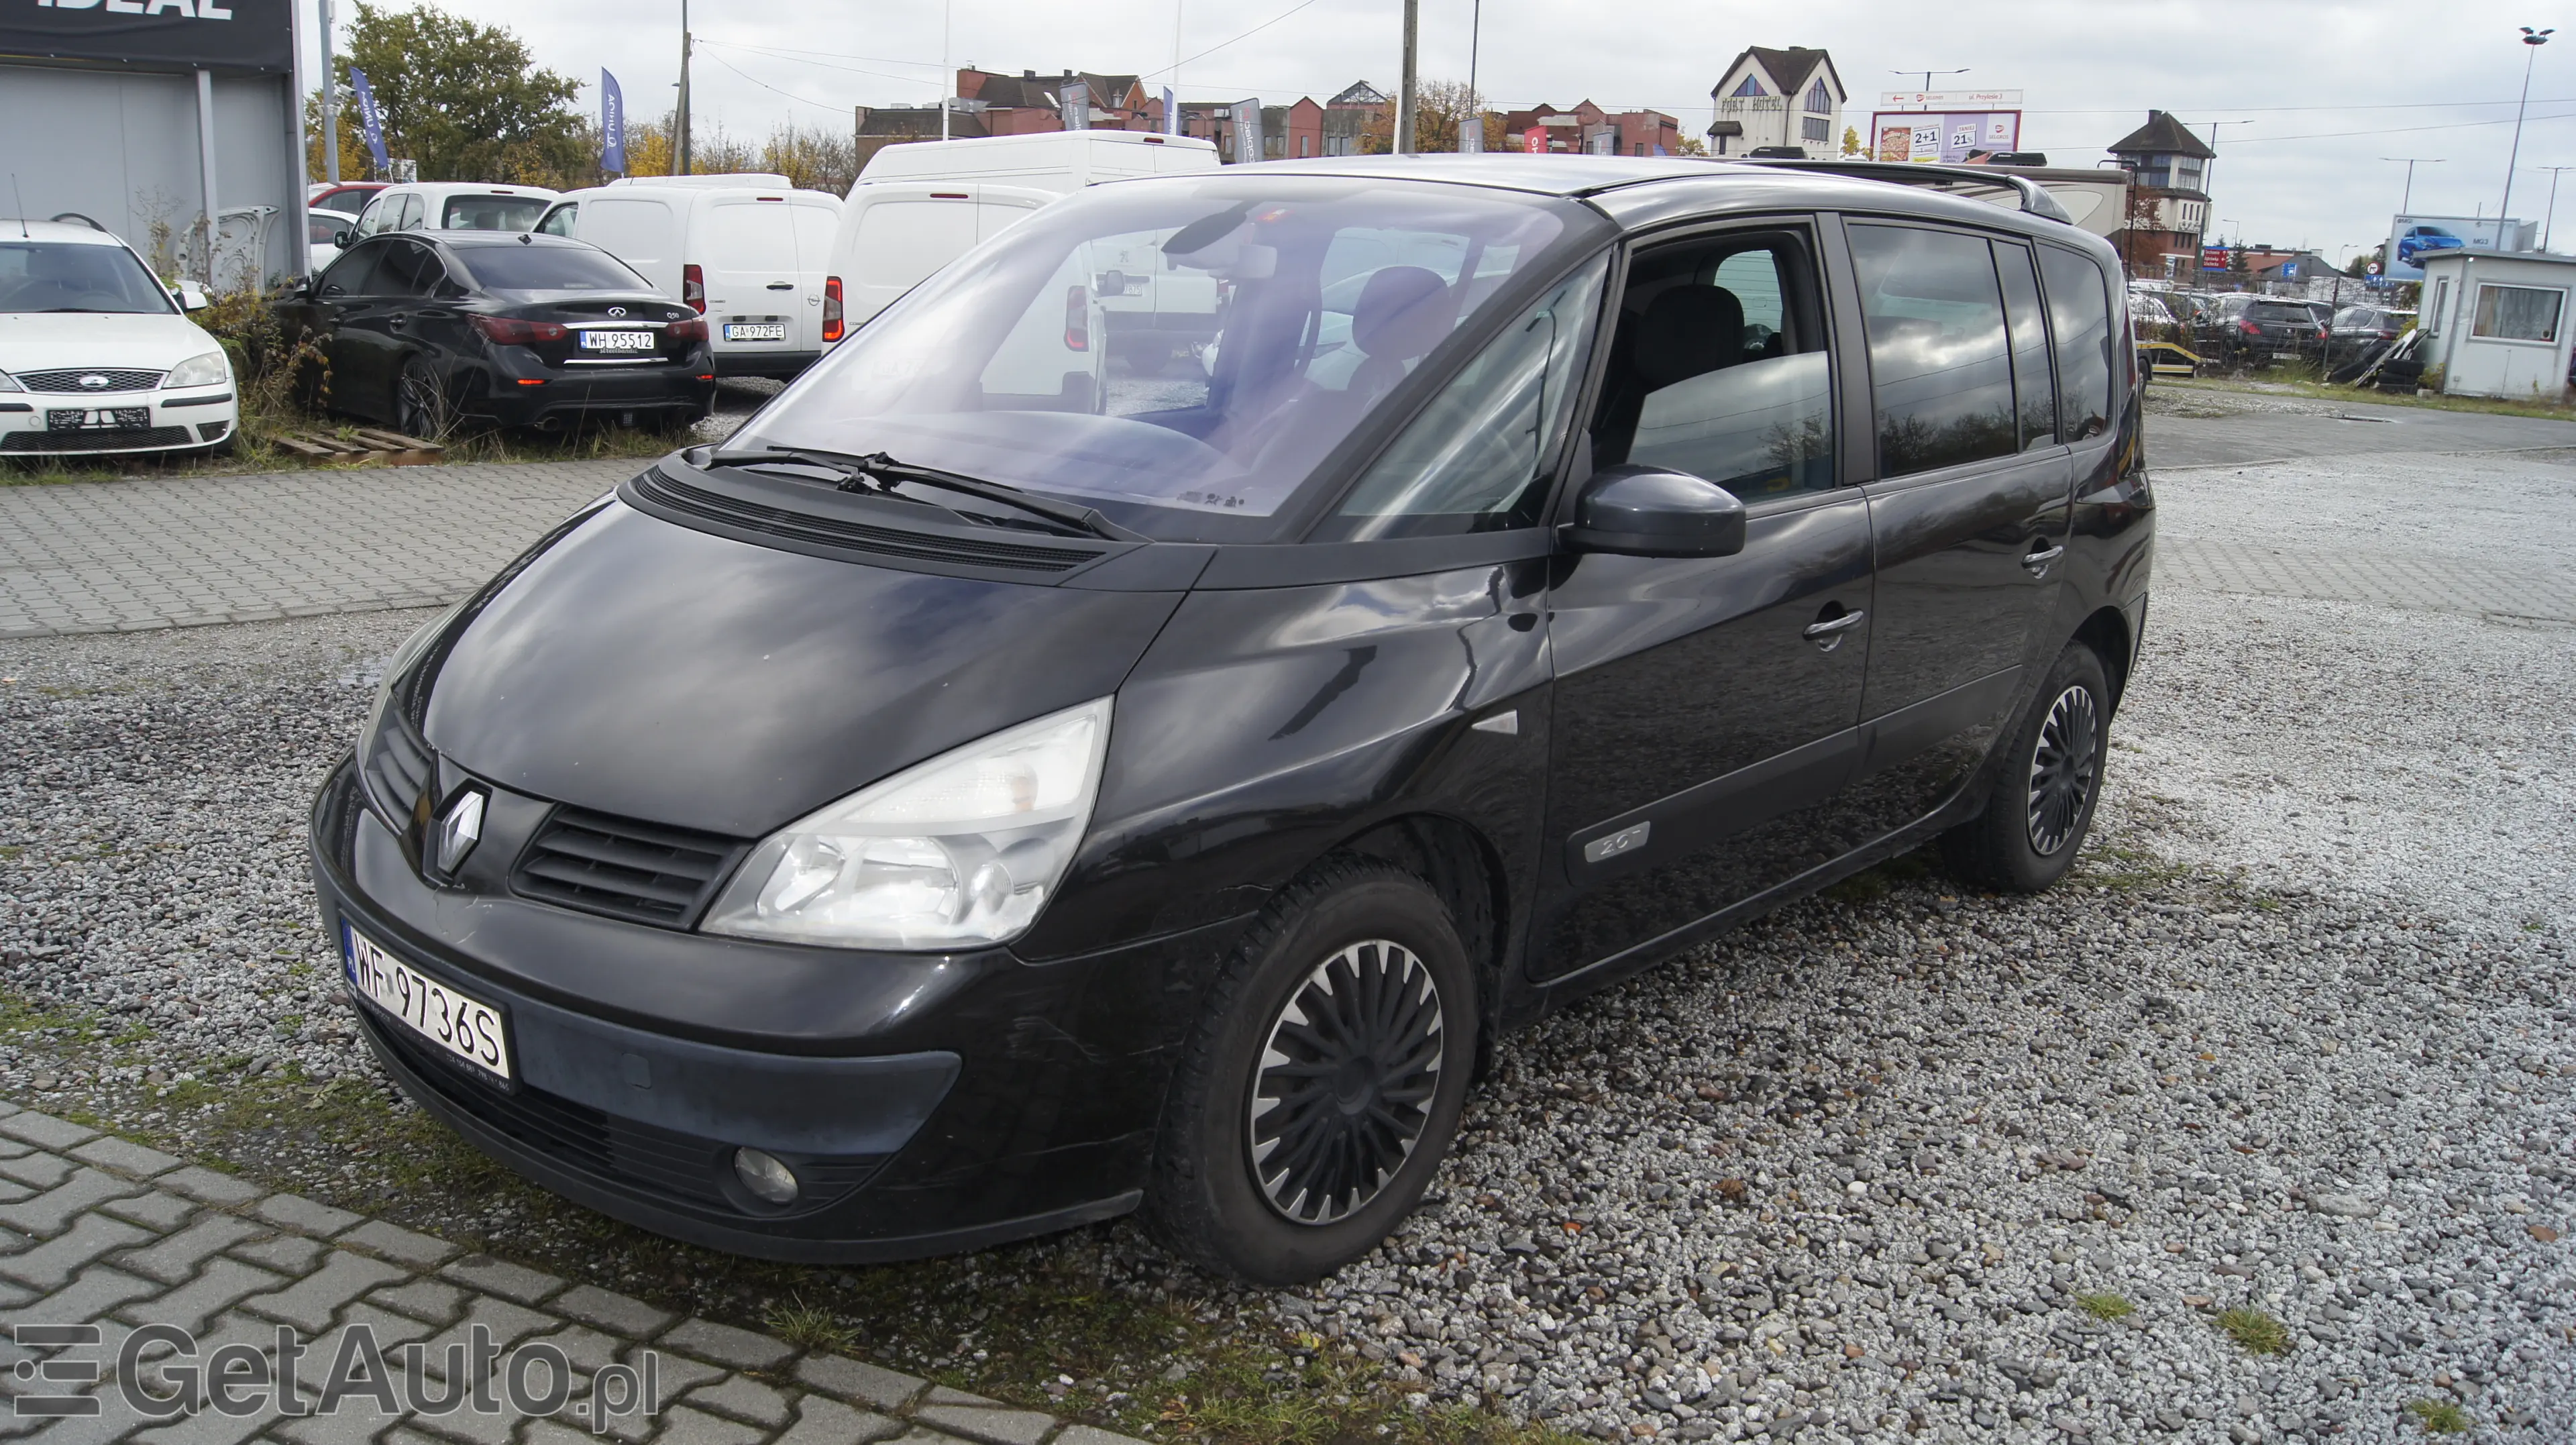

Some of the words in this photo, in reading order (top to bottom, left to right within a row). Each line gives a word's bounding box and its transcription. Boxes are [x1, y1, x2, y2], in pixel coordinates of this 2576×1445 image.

[1721, 97, 1745, 113] FORT
[1752, 96, 1782, 111] HOTEL
[1915, 131, 1937, 144] 2+1
[732, 326, 746, 337] GA
[750, 325, 782, 337] 972FE
[590, 334, 606, 347] WH
[612, 333, 651, 347] 95512
[347, 957, 356, 974] PL
[354, 932, 386, 998] WF
[396, 966, 501, 1067] 9736S
